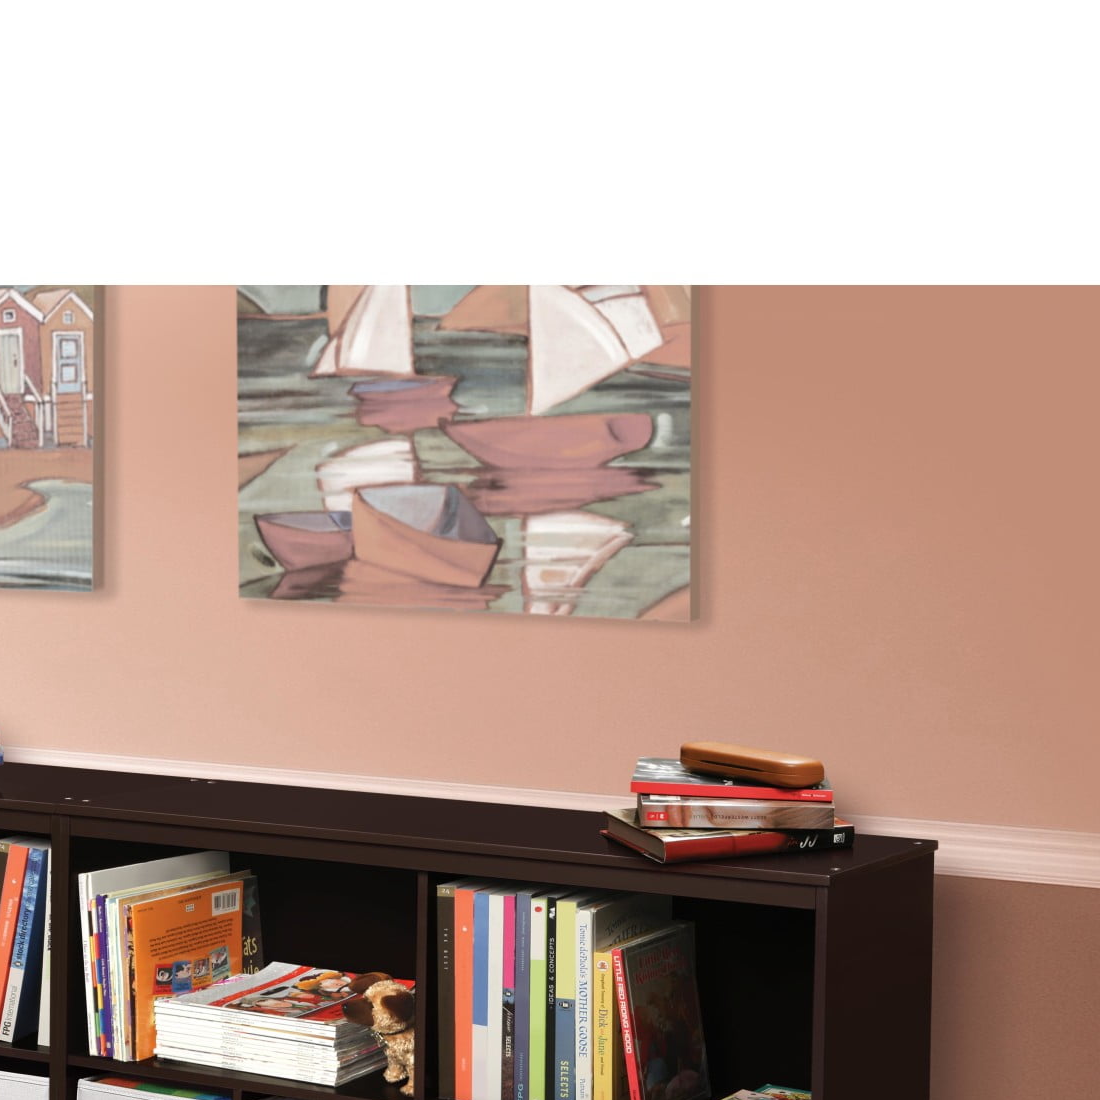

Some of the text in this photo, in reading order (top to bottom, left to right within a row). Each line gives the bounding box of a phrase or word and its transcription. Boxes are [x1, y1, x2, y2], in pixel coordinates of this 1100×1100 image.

[18, 907, 32, 938] directory
[16, 938, 26, 960] stock
[242, 936, 258, 956] ats
[579, 981, 588, 1024] MOTHER
[613, 955, 632, 1054] LITTLE RED RIDING HOOD
[2, 1021, 12, 1036] FPG
[598, 1009, 608, 1028] Dick
[579, 1026, 588, 1058] GOOSE
[598, 1035, 608, 1056] Jane
[560, 1061, 569, 1098] SELECTS
